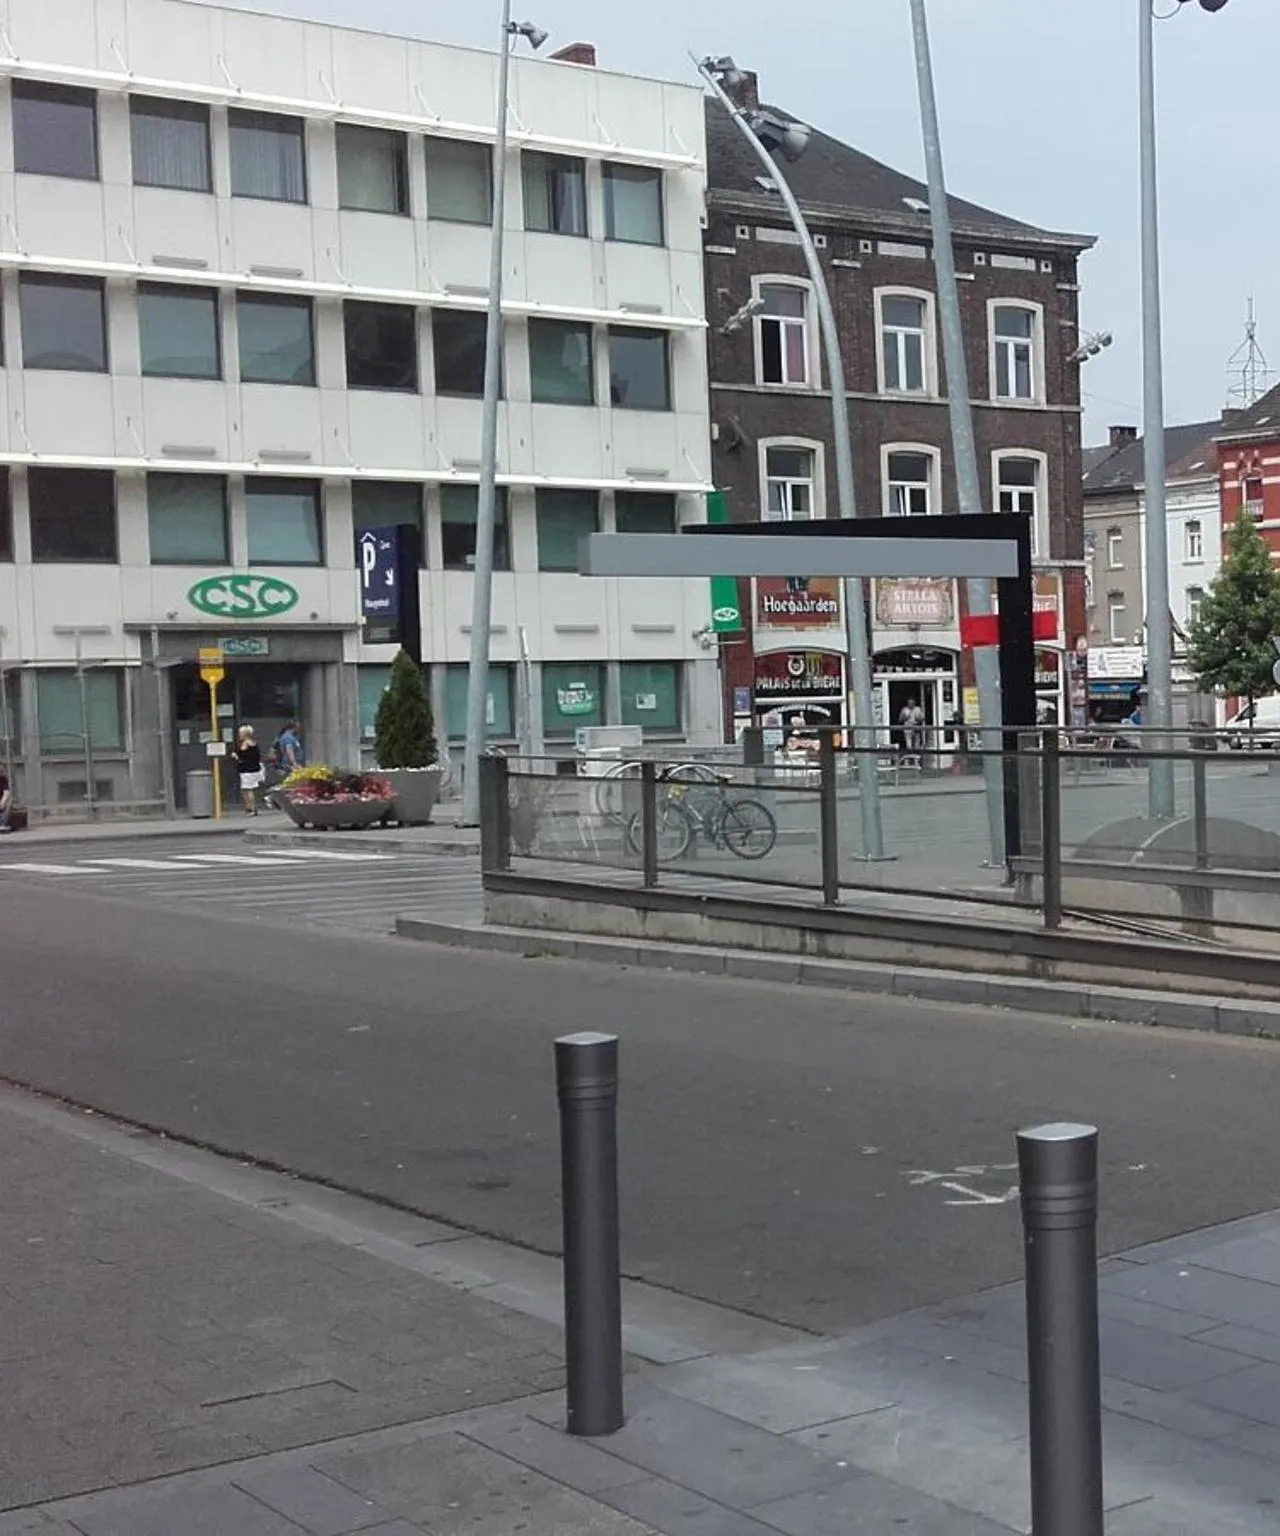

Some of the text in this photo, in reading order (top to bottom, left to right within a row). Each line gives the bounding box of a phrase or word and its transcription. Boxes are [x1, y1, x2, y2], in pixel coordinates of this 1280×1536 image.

[363, 542, 376, 588] P
[197, 578, 292, 616] CSC
[894, 589, 938, 602] STELLA
[763, 594, 838, 615] Hoegaarden
[894, 602, 938, 615] ARTOIS
[756, 676, 790, 690] PALAIS
